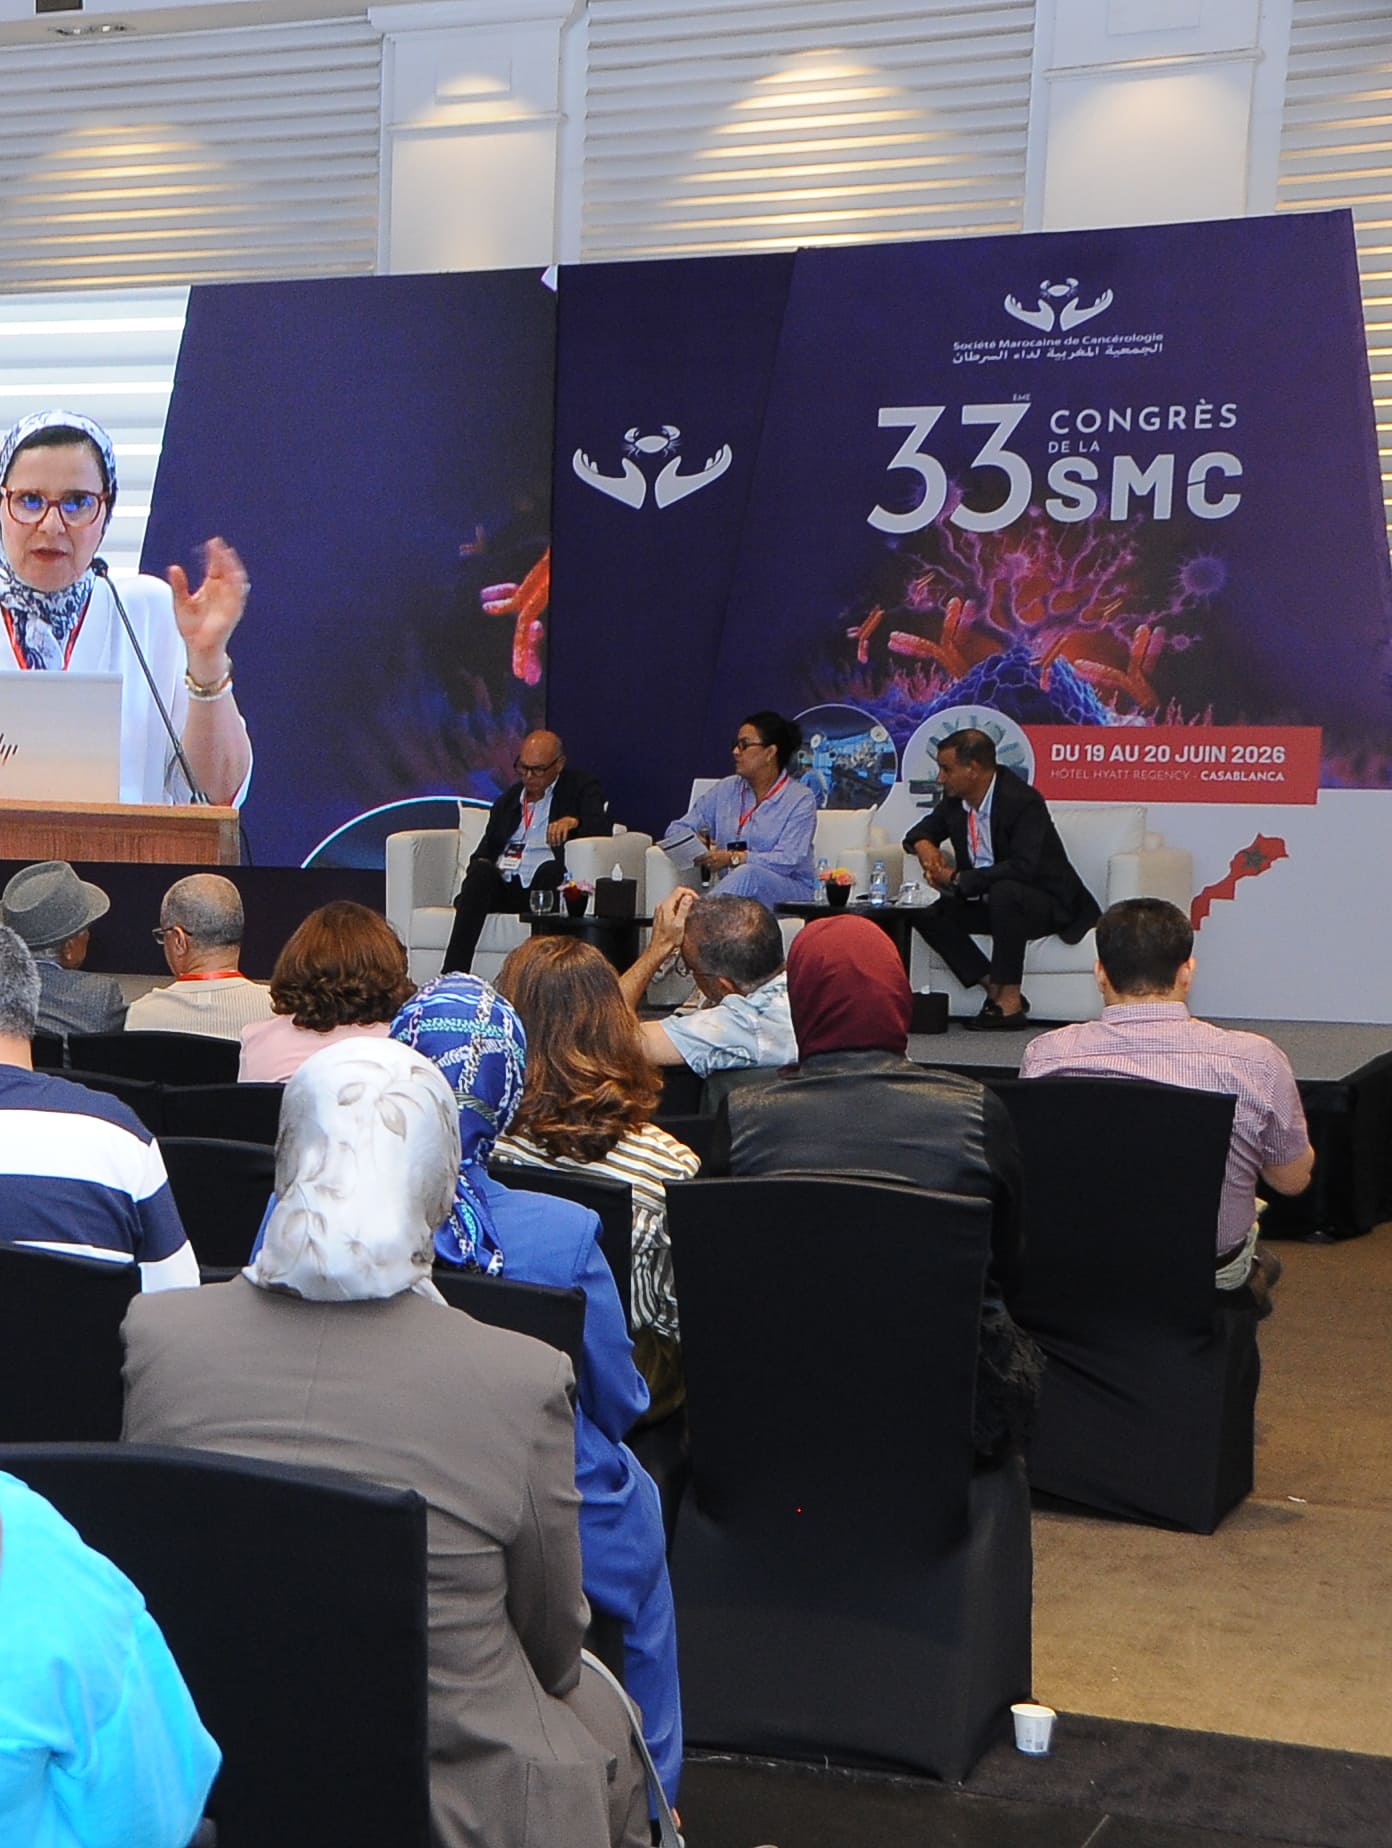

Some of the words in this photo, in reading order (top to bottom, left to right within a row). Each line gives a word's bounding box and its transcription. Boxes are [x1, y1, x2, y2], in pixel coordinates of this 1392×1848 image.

[952, 340, 996, 351] Société
[998, 337, 1061, 349] Marocaine
[1064, 335, 1080, 346] de
[1082, 332, 1164, 346] Cancérologie
[952, 350, 1009, 364] السرطان
[1013, 349, 1041, 360] لداء
[1046, 346, 1100, 361] المغربية
[1104, 343, 1163, 357] الجمعية
[1048, 441, 1071, 453] DE
[1079, 440, 1101, 453] LA
[866, 402, 1033, 534] 33
[1049, 398, 1238, 435] CONGRÈS
[1045, 451, 1244, 523] SMC
[1051, 744, 1080, 762] DU
[1084, 744, 1105, 762] 19
[1109, 744, 1139, 763] AU
[1144, 745, 1170, 763] 20
[1175, 745, 1226, 763] JUIN
[1231, 746, 1286, 764] 2026
[1050, 766, 1089, 780] HÔTEL
[1093, 767, 1129, 780] HYATT
[1133, 768, 1191, 781] REGENCY
[1200, 770, 1285, 782] CASABLANCA
